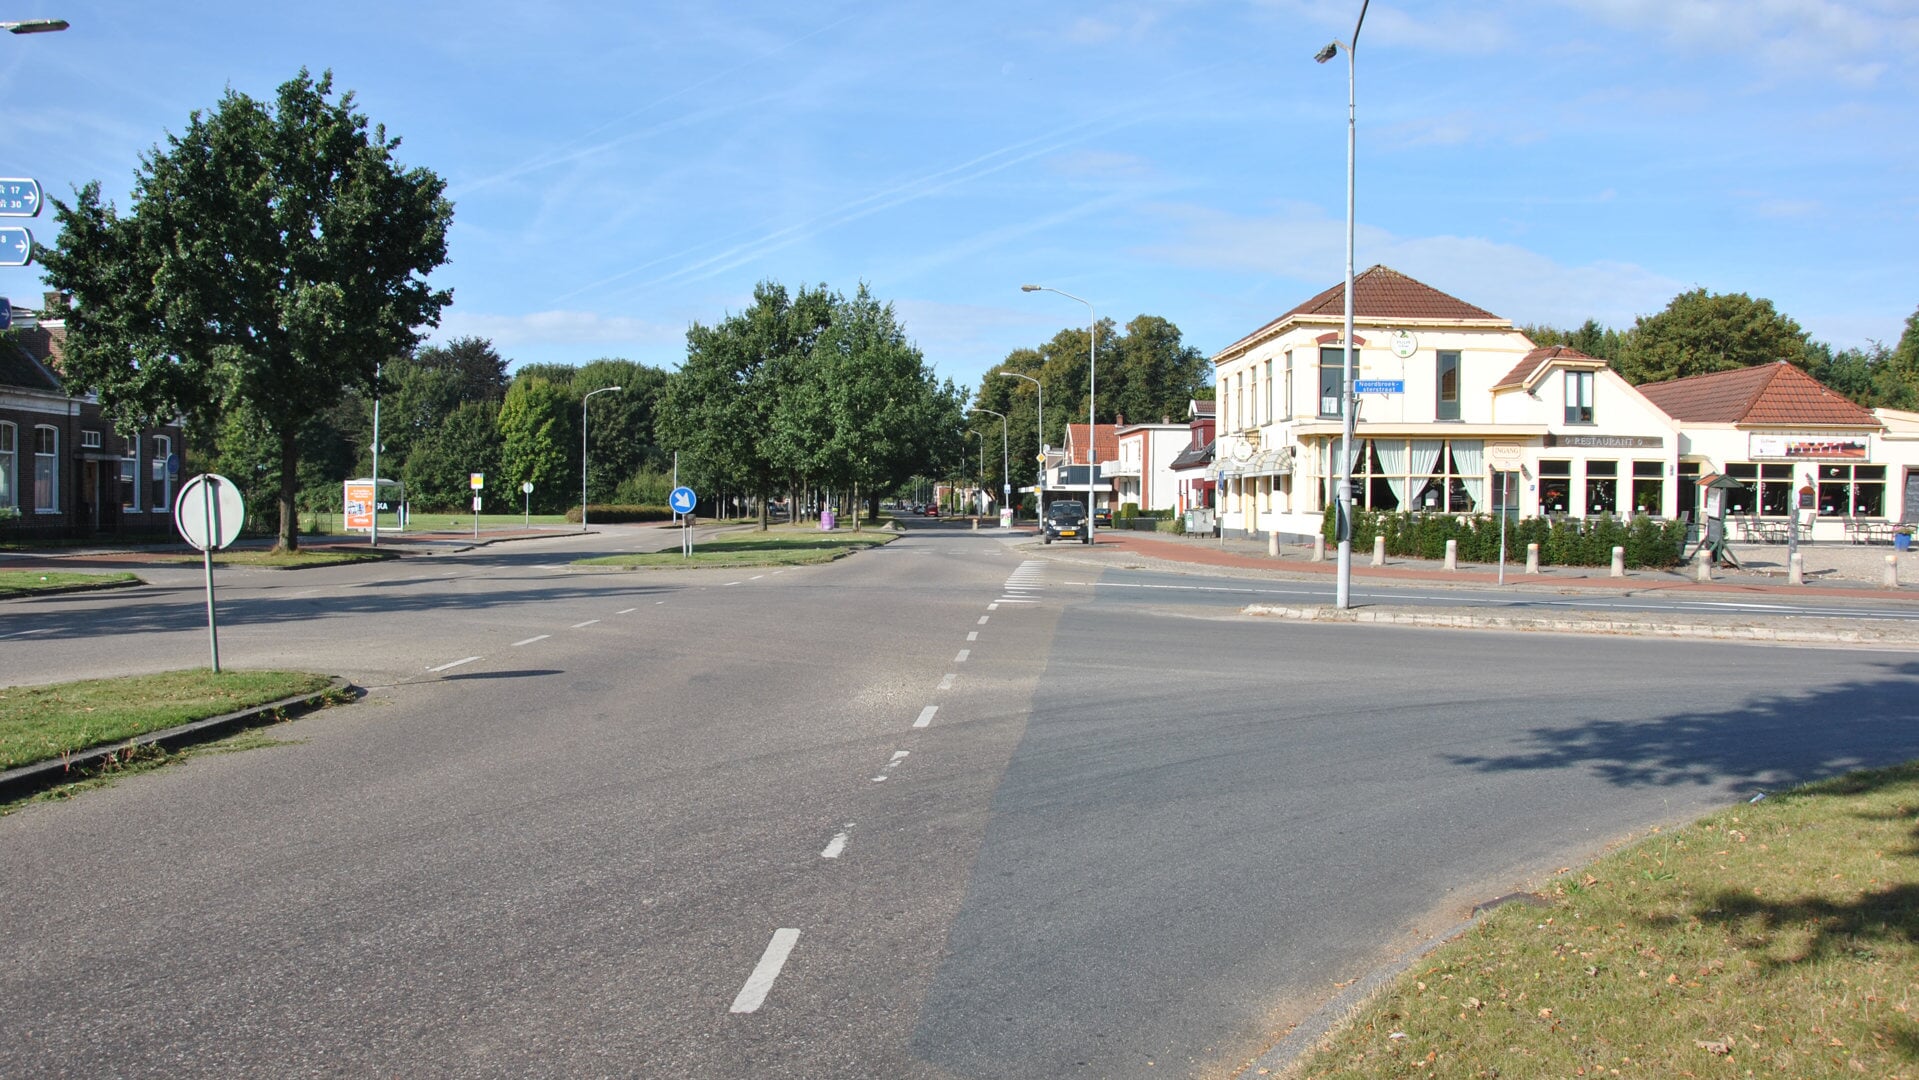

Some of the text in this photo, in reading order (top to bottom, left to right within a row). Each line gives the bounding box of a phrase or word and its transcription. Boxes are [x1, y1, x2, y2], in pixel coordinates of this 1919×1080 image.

[10, 186, 20, 194] 17
[10, 200, 22, 208] 30
[1574, 437, 1634, 446] RESTAURANT
